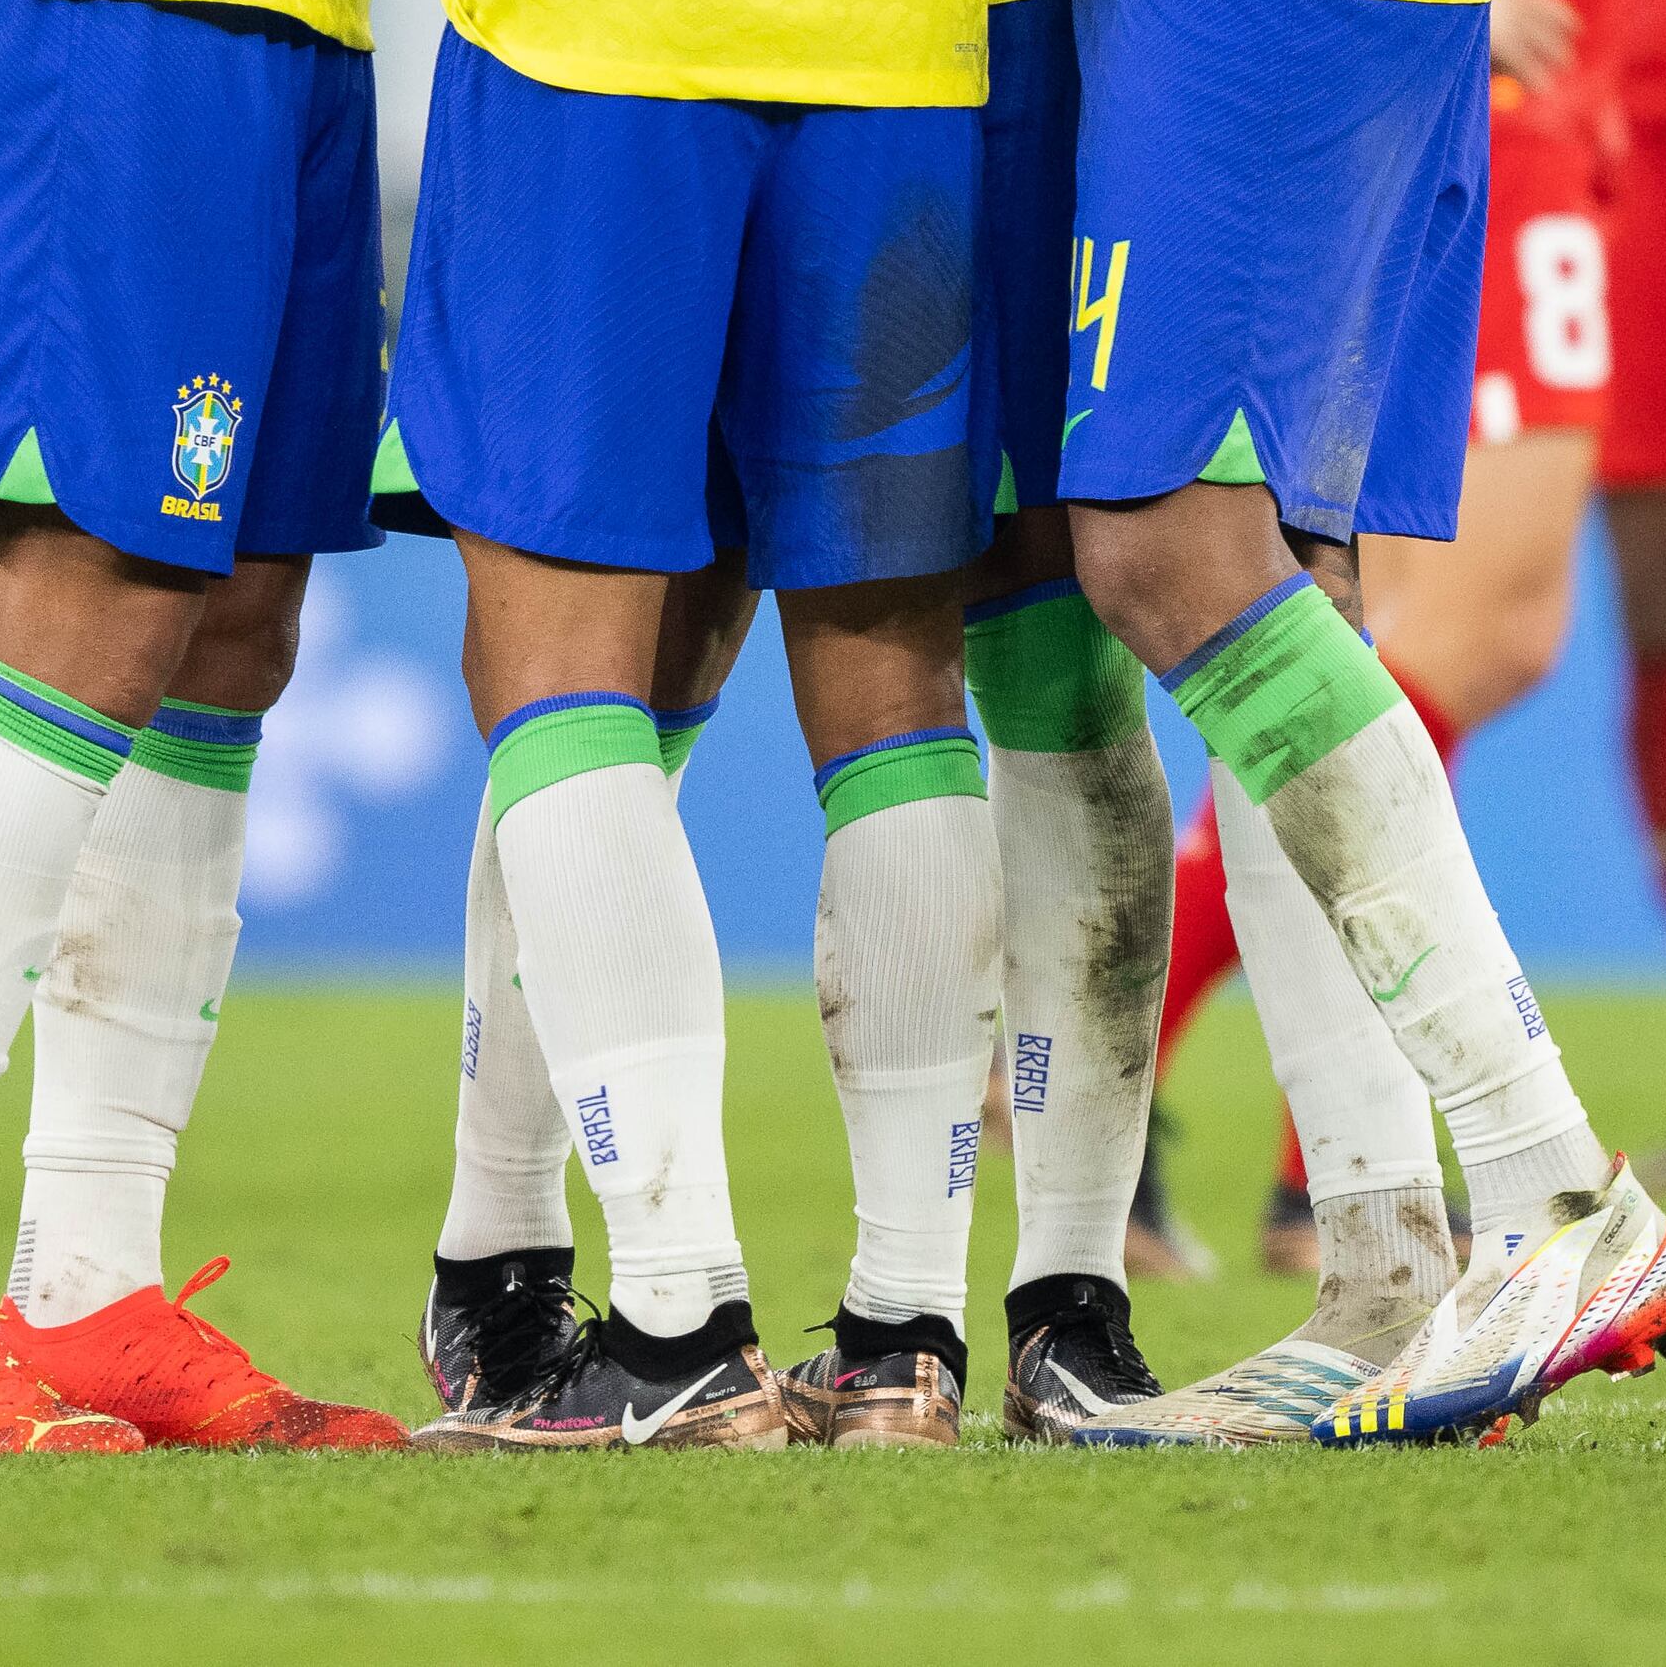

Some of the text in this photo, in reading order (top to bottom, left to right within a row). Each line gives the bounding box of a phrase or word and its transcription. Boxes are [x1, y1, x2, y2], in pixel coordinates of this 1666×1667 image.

[1517, 215, 1613, 391] 8
[193, 434, 216, 448] CBF
[160, 495, 222, 521] BRASIL
[1013, 1033, 1053, 1118] BRASIL
[576, 1085, 619, 1166] BRASIL
[948, 1120, 981, 1198] BRASIL
